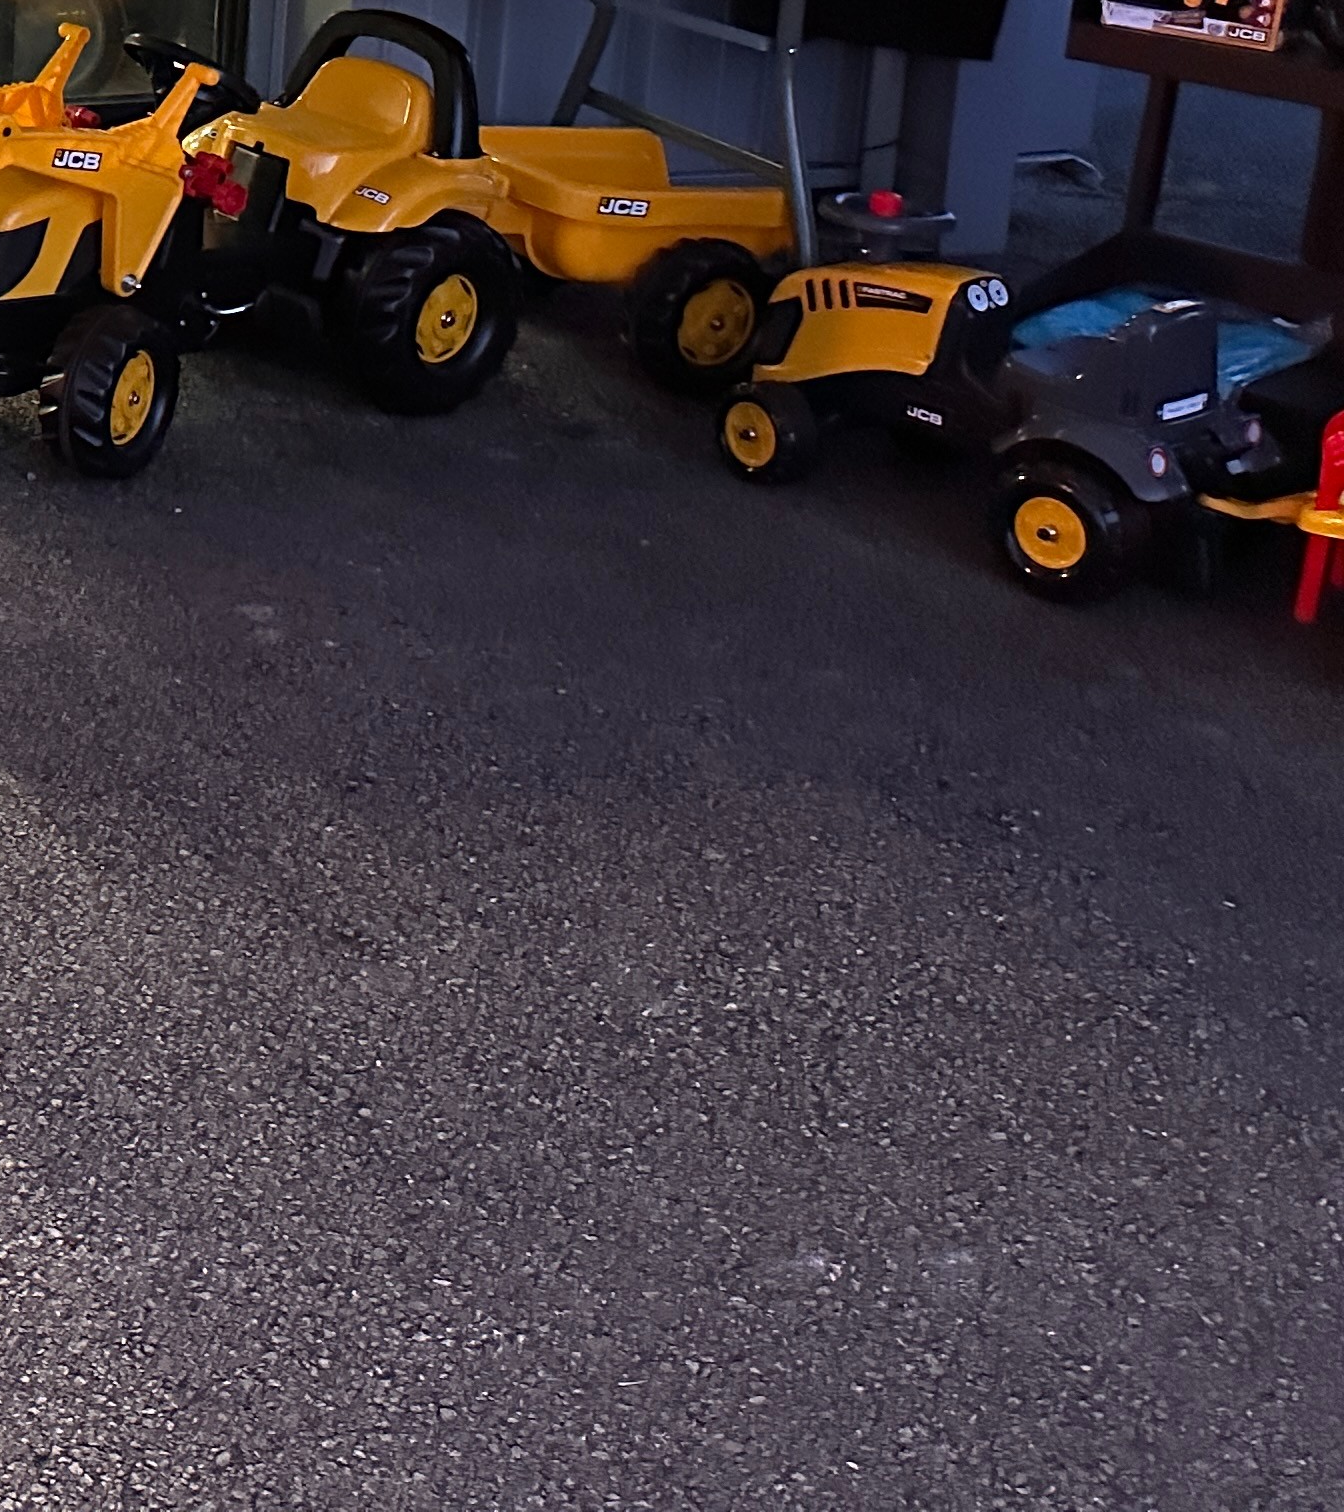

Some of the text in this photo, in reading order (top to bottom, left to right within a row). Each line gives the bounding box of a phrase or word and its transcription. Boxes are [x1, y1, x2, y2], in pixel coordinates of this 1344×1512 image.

[1228, 27, 1266, 42] JCB
[54, 151, 101, 170] JCB
[356, 187, 390, 204] JCB
[599, 198, 649, 216] JCB
[907, 405, 943, 426] JCB
